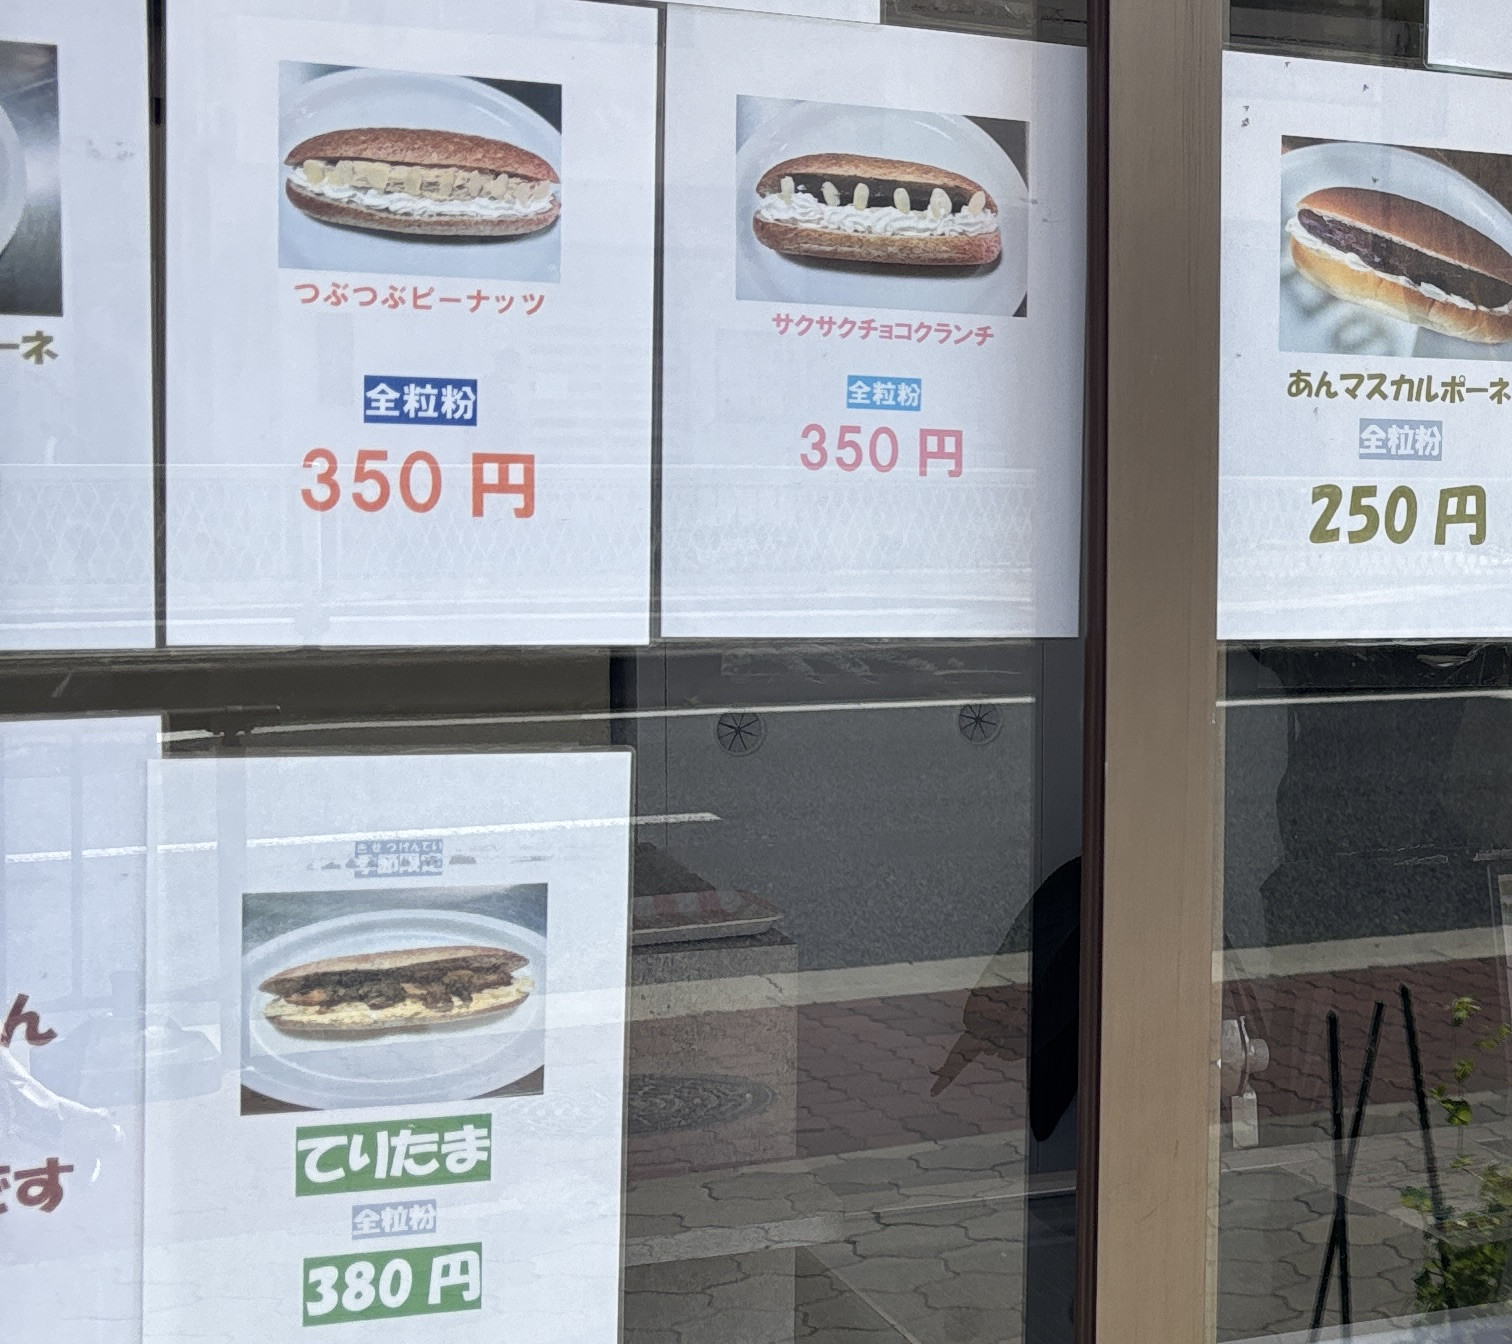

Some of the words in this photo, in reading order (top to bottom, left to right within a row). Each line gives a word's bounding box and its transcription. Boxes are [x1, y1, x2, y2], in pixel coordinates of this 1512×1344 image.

[294, 282, 546, 316] つぶつぶピーナッツ
[772, 313, 994, 346] サクサクチョコクランチ
[365, 381, 476, 421] 全粒粉
[848, 380, 920, 408] 全粒粉
[1286, 369, 1512, 405] あんマスカルポーネ
[1360, 423, 1441, 456] 全粒粉
[297, 1123, 491, 1184] てりたま
[0, 1158, 74, 1214] す
[355, 1204, 436, 1234] 全粒粉
